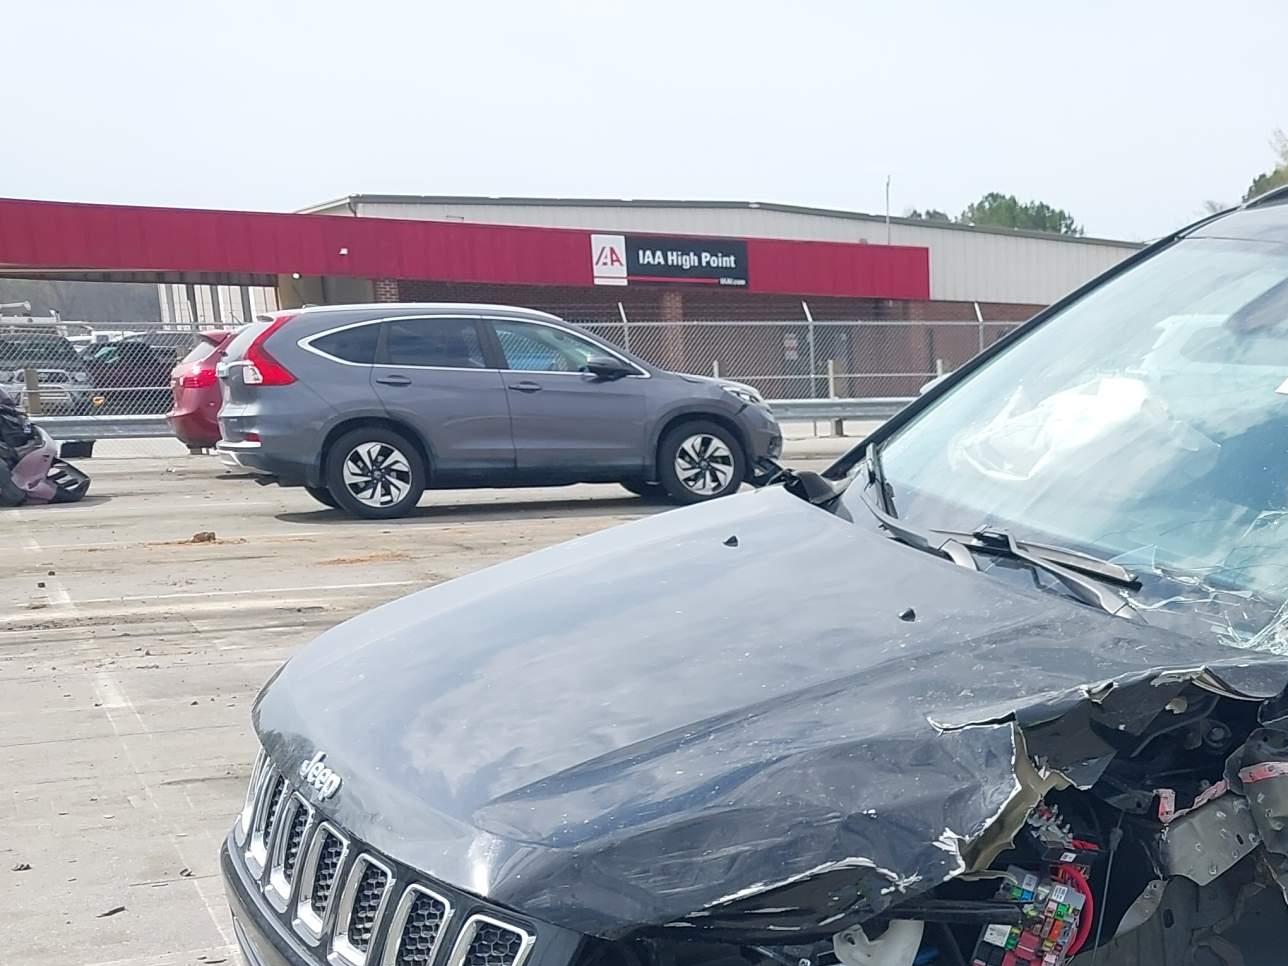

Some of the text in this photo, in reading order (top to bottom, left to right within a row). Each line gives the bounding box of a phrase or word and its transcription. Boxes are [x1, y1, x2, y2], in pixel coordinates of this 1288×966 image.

[638, 249, 736, 269] IAA High Point
[299, 750, 342, 801] Jeep
